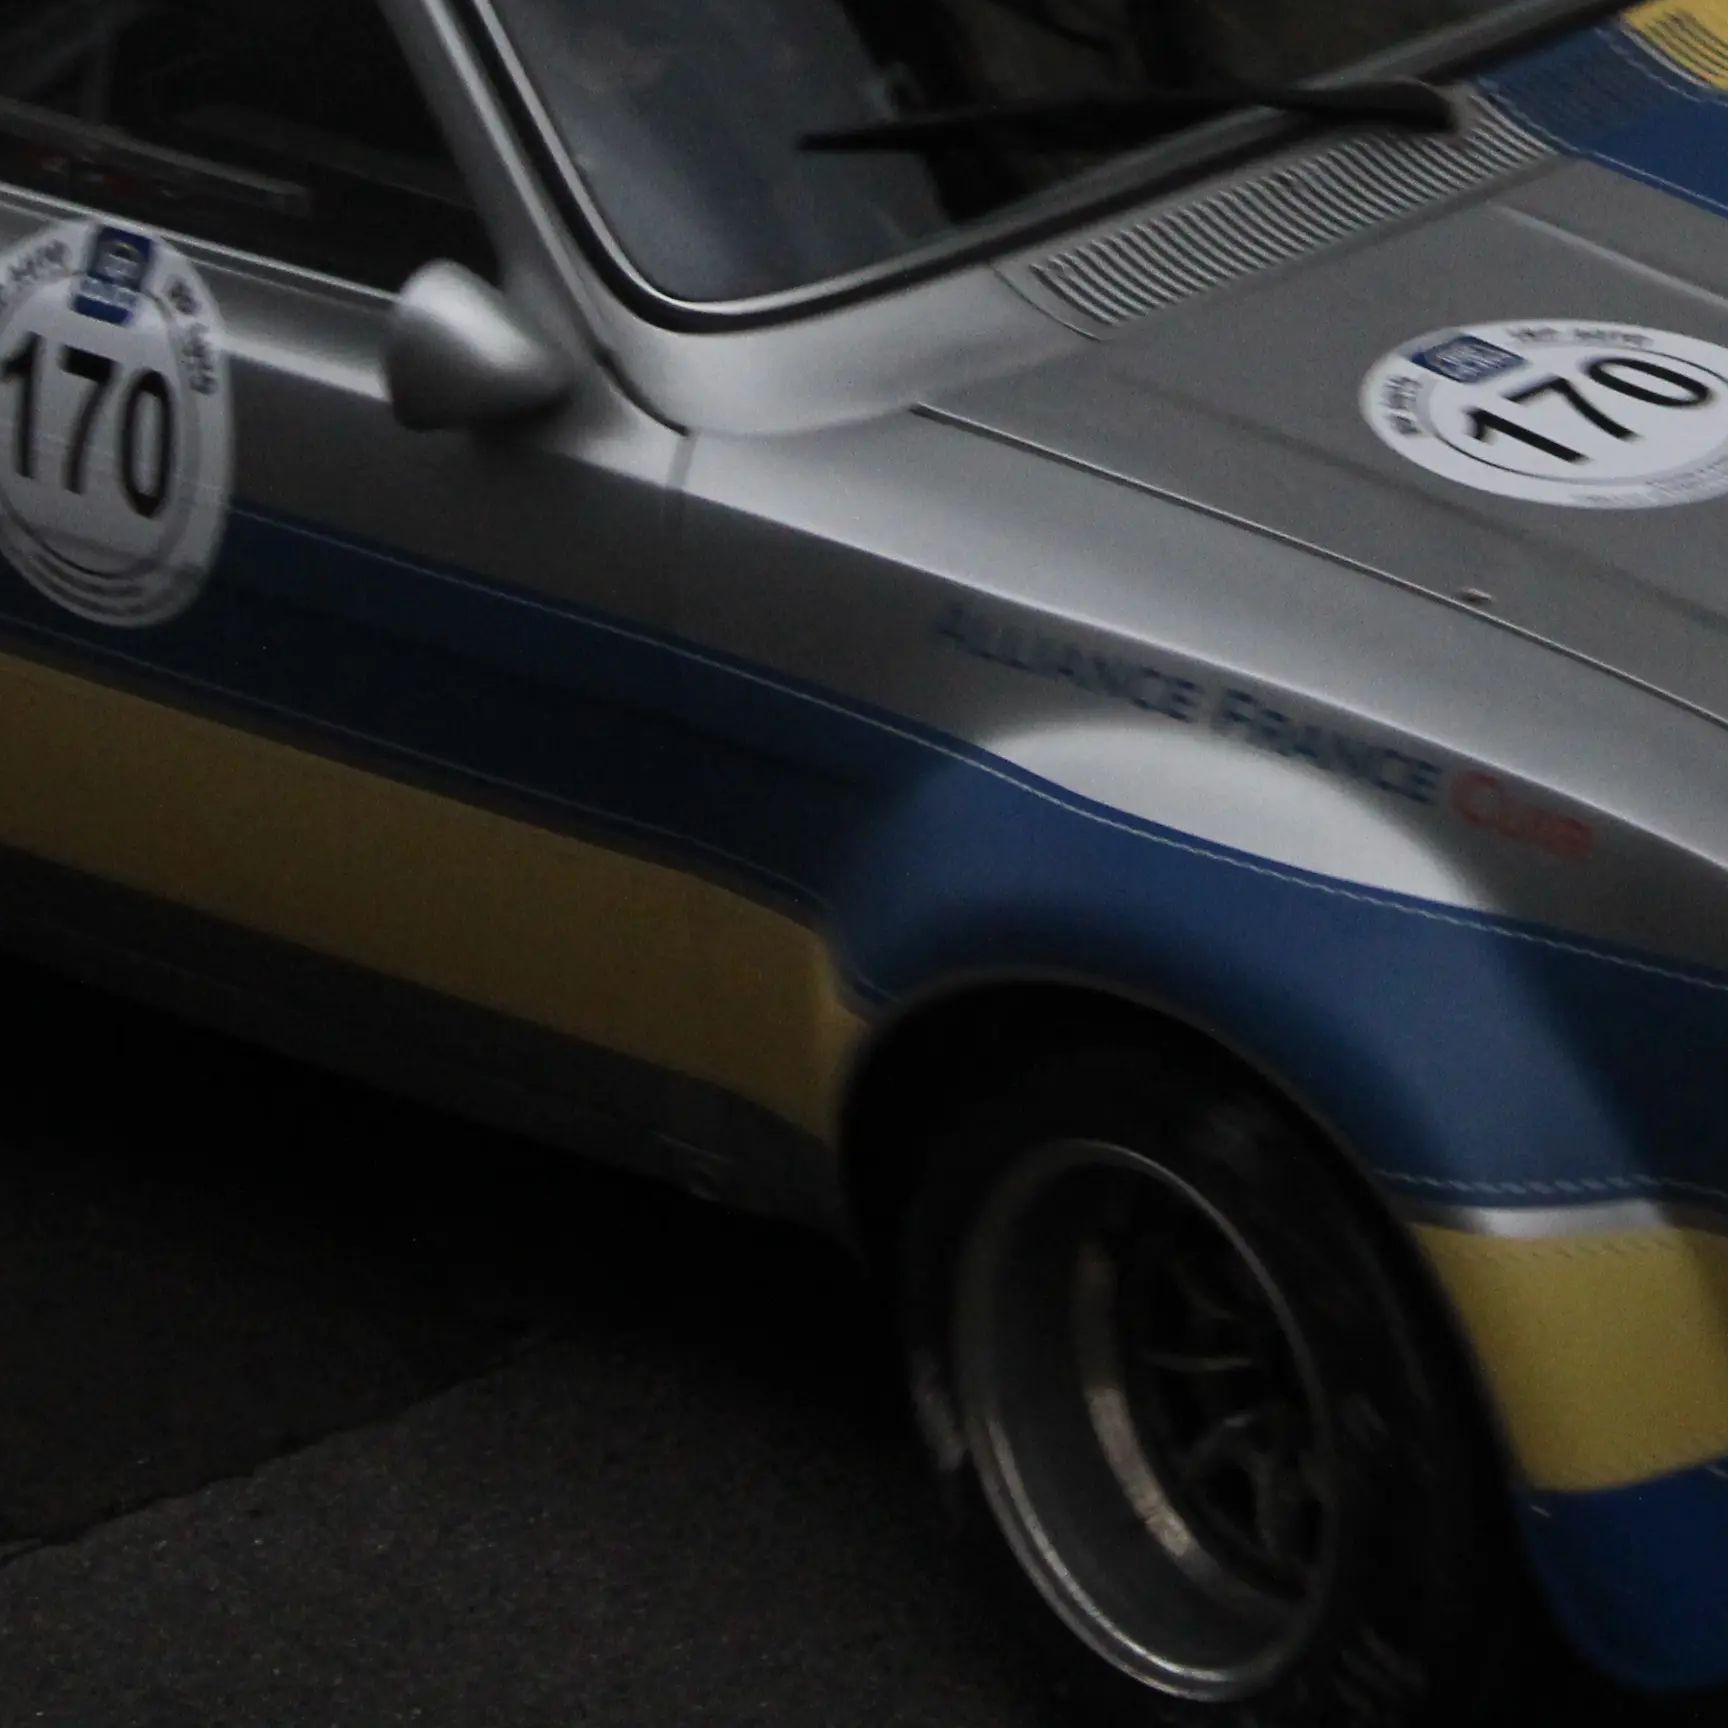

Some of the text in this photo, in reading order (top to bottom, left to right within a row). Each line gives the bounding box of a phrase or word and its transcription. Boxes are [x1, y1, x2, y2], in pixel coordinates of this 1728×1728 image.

[0, 329, 172, 520] 170
[1465, 357, 1714, 464] 170
[1210, 685, 1443, 808] FRANCE
